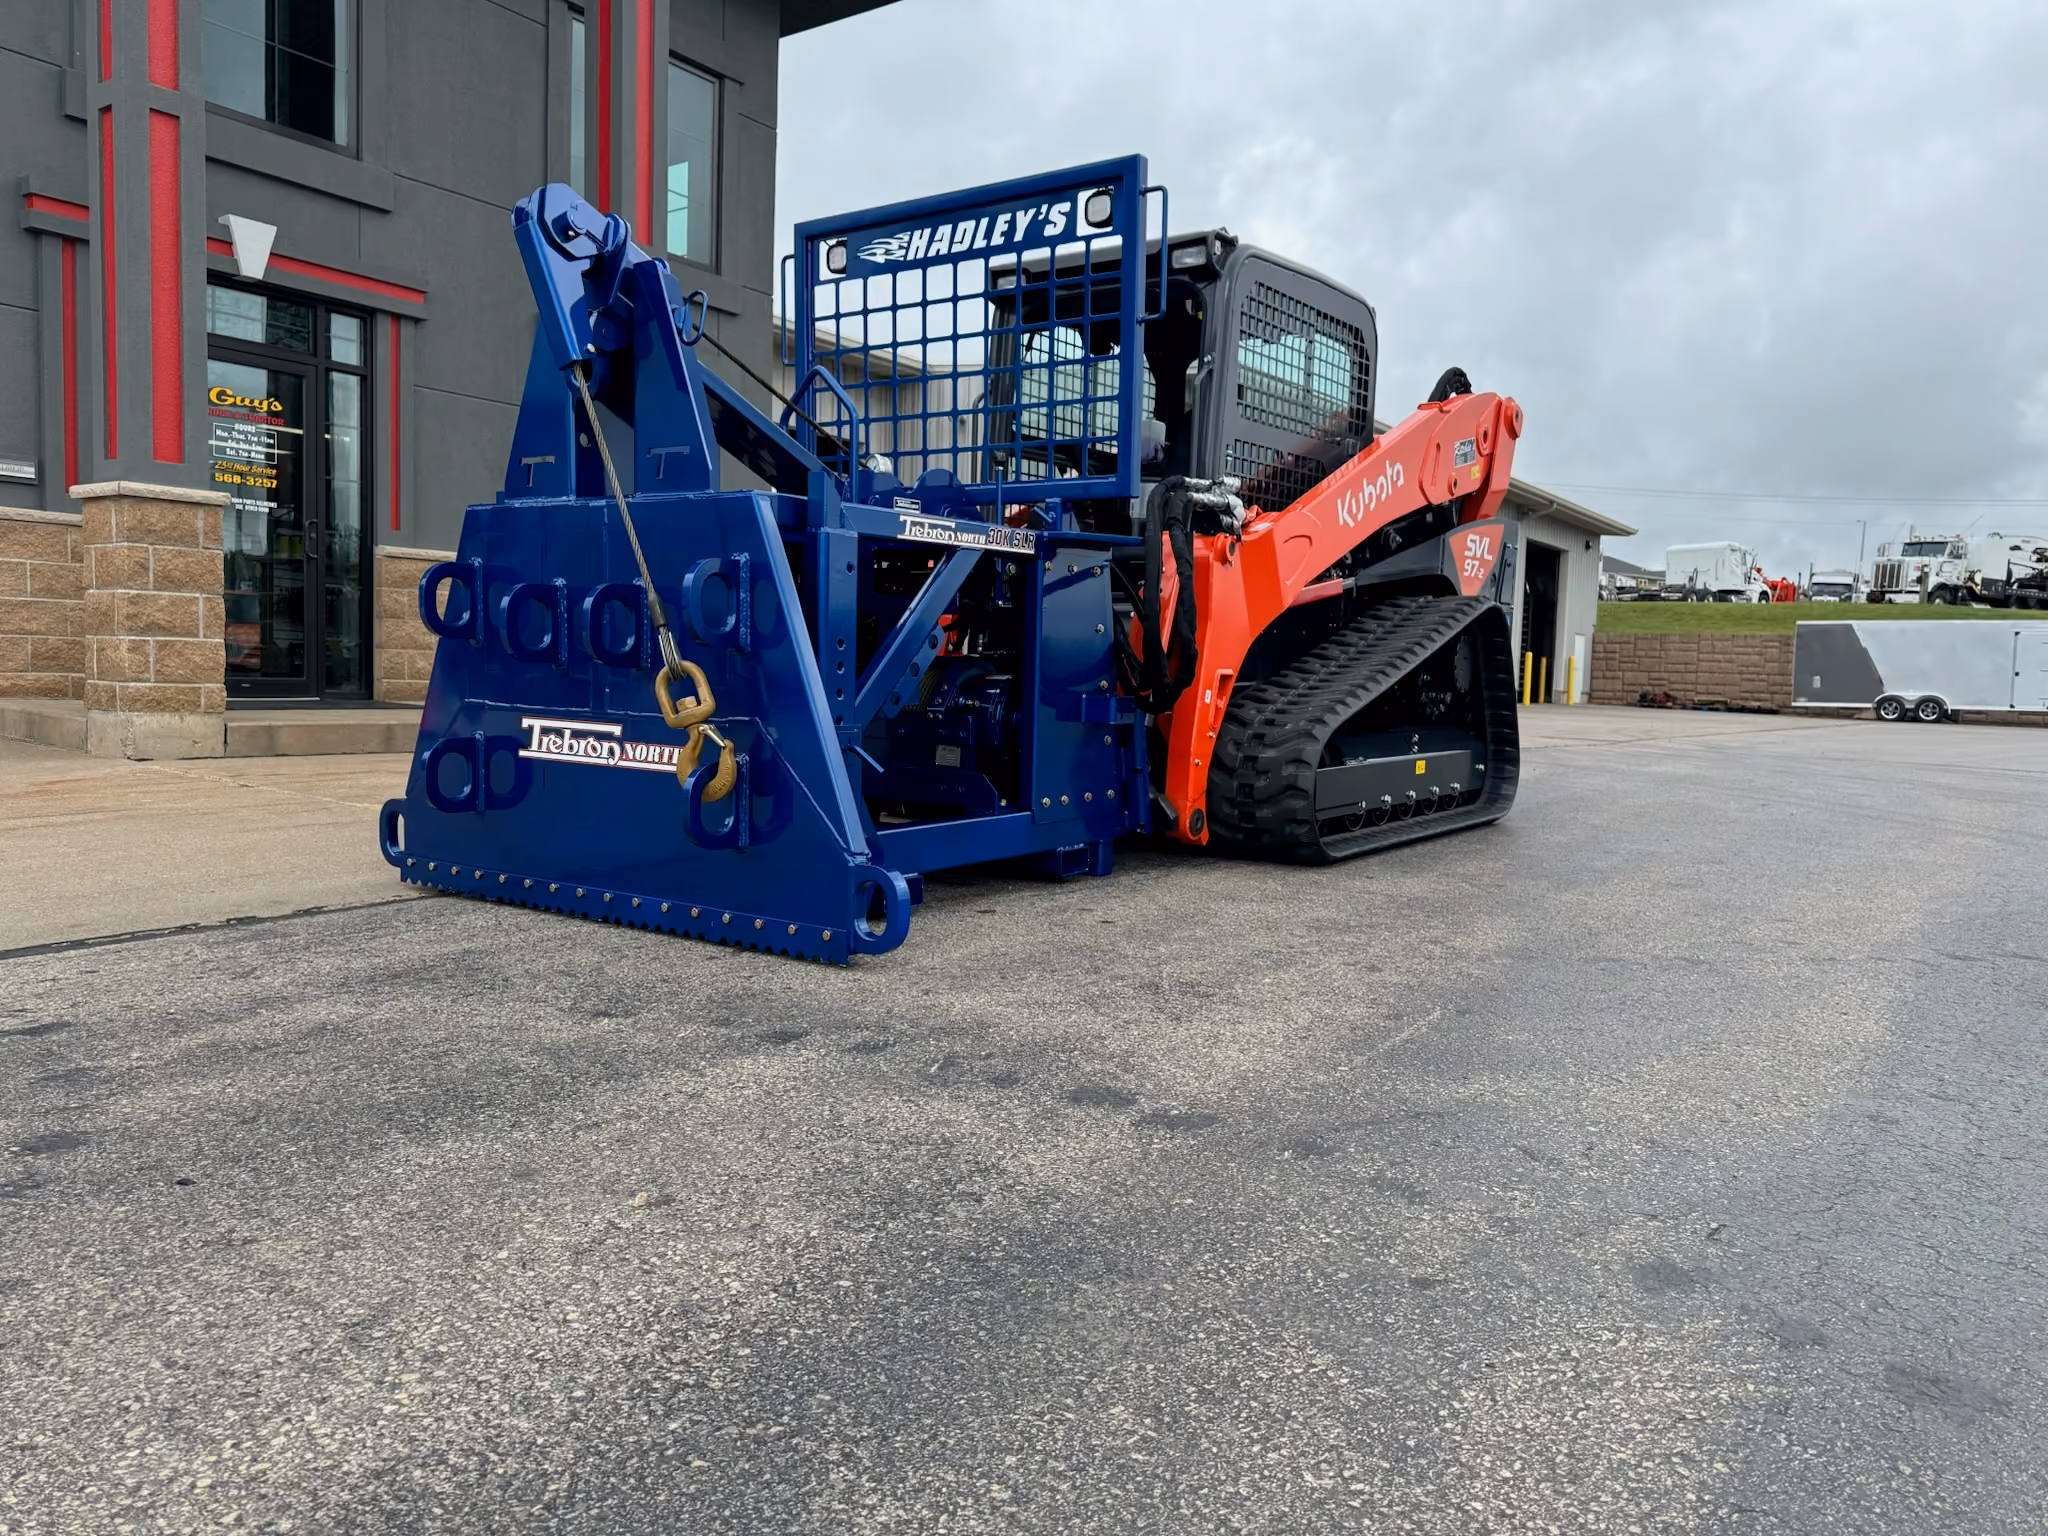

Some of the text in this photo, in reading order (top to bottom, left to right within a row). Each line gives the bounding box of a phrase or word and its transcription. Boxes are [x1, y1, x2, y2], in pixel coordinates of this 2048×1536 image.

[906, 201, 1072, 261] HADLEY'S
[209, 386, 283, 412] Guy's
[234, 423, 256, 433] HOURS
[214, 472, 278, 489] 568-3257
[233, 463, 251, 472] Hour
[251, 465, 277, 476] Service
[1337, 460, 1404, 528] Kubota
[899, 515, 1036, 551] Trebron NORTH 30K SLR
[1464, 534, 1493, 561] SVL
[521, 717, 622, 765] Trebron
